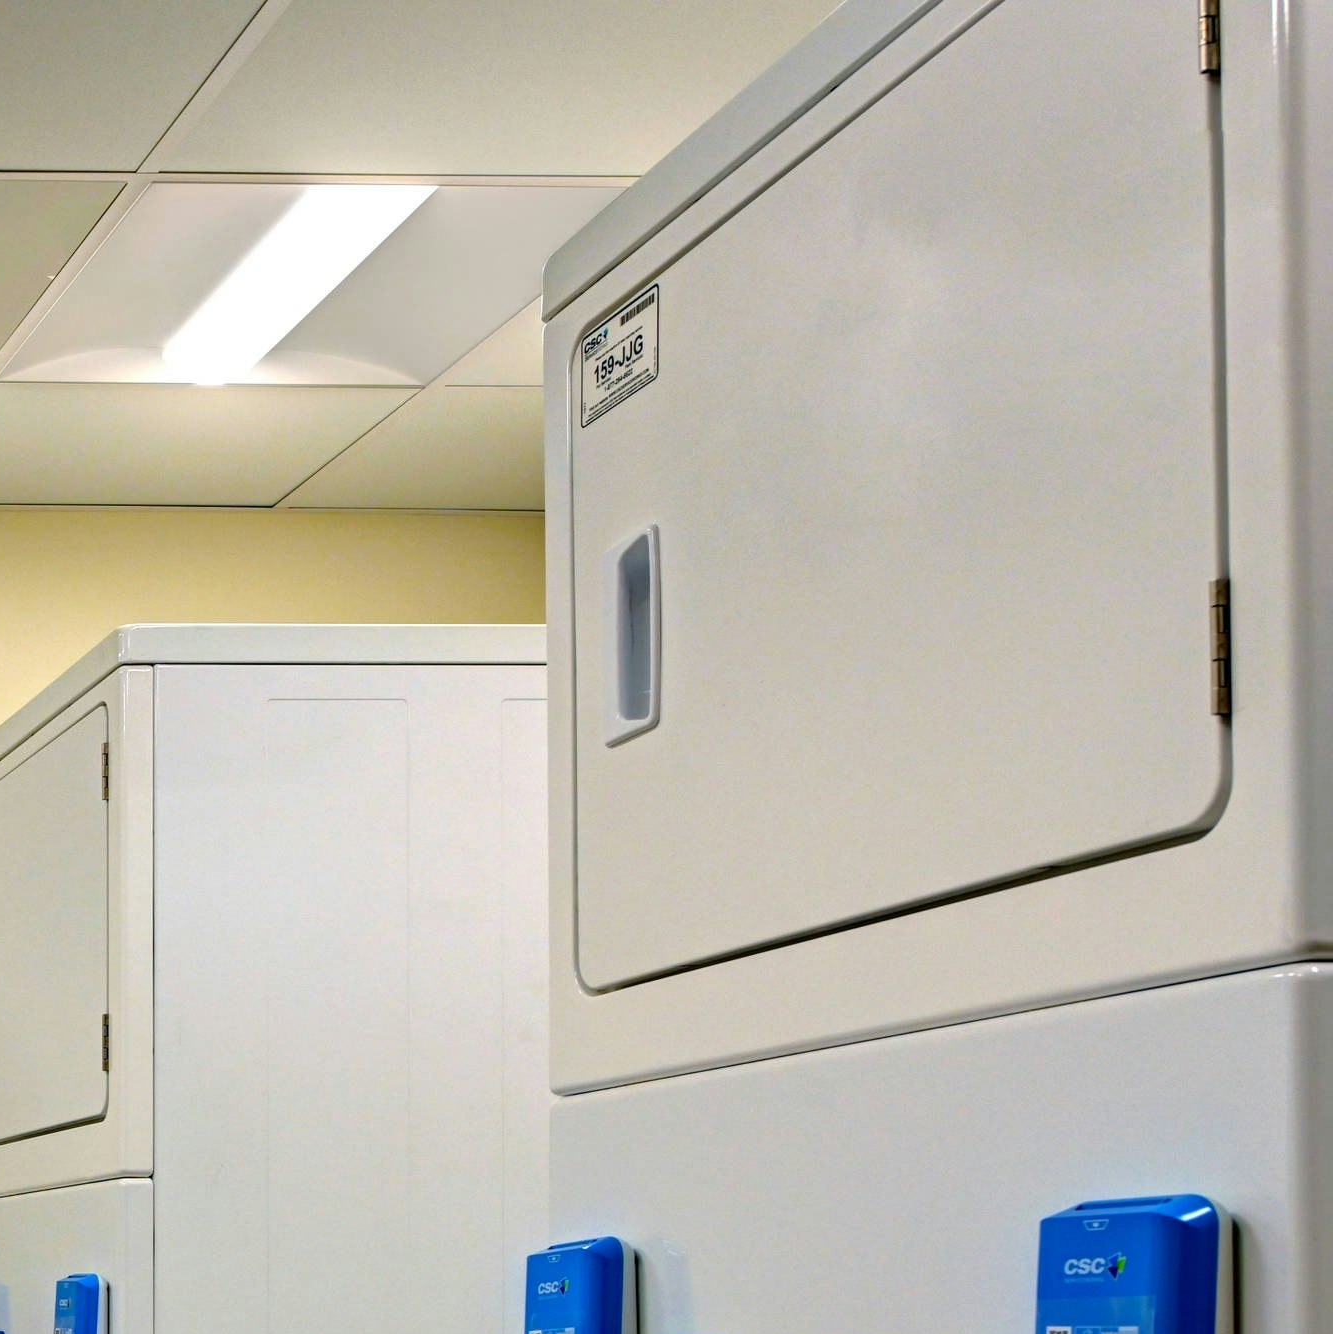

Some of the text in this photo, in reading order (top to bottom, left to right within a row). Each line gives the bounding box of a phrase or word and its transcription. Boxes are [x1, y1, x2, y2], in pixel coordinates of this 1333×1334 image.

[584, 333, 602, 354] CSC
[594, 334, 643, 384] 159-JJG
[1064, 1257, 1105, 1276] CSC
[538, 1281, 559, 1295] CSC
